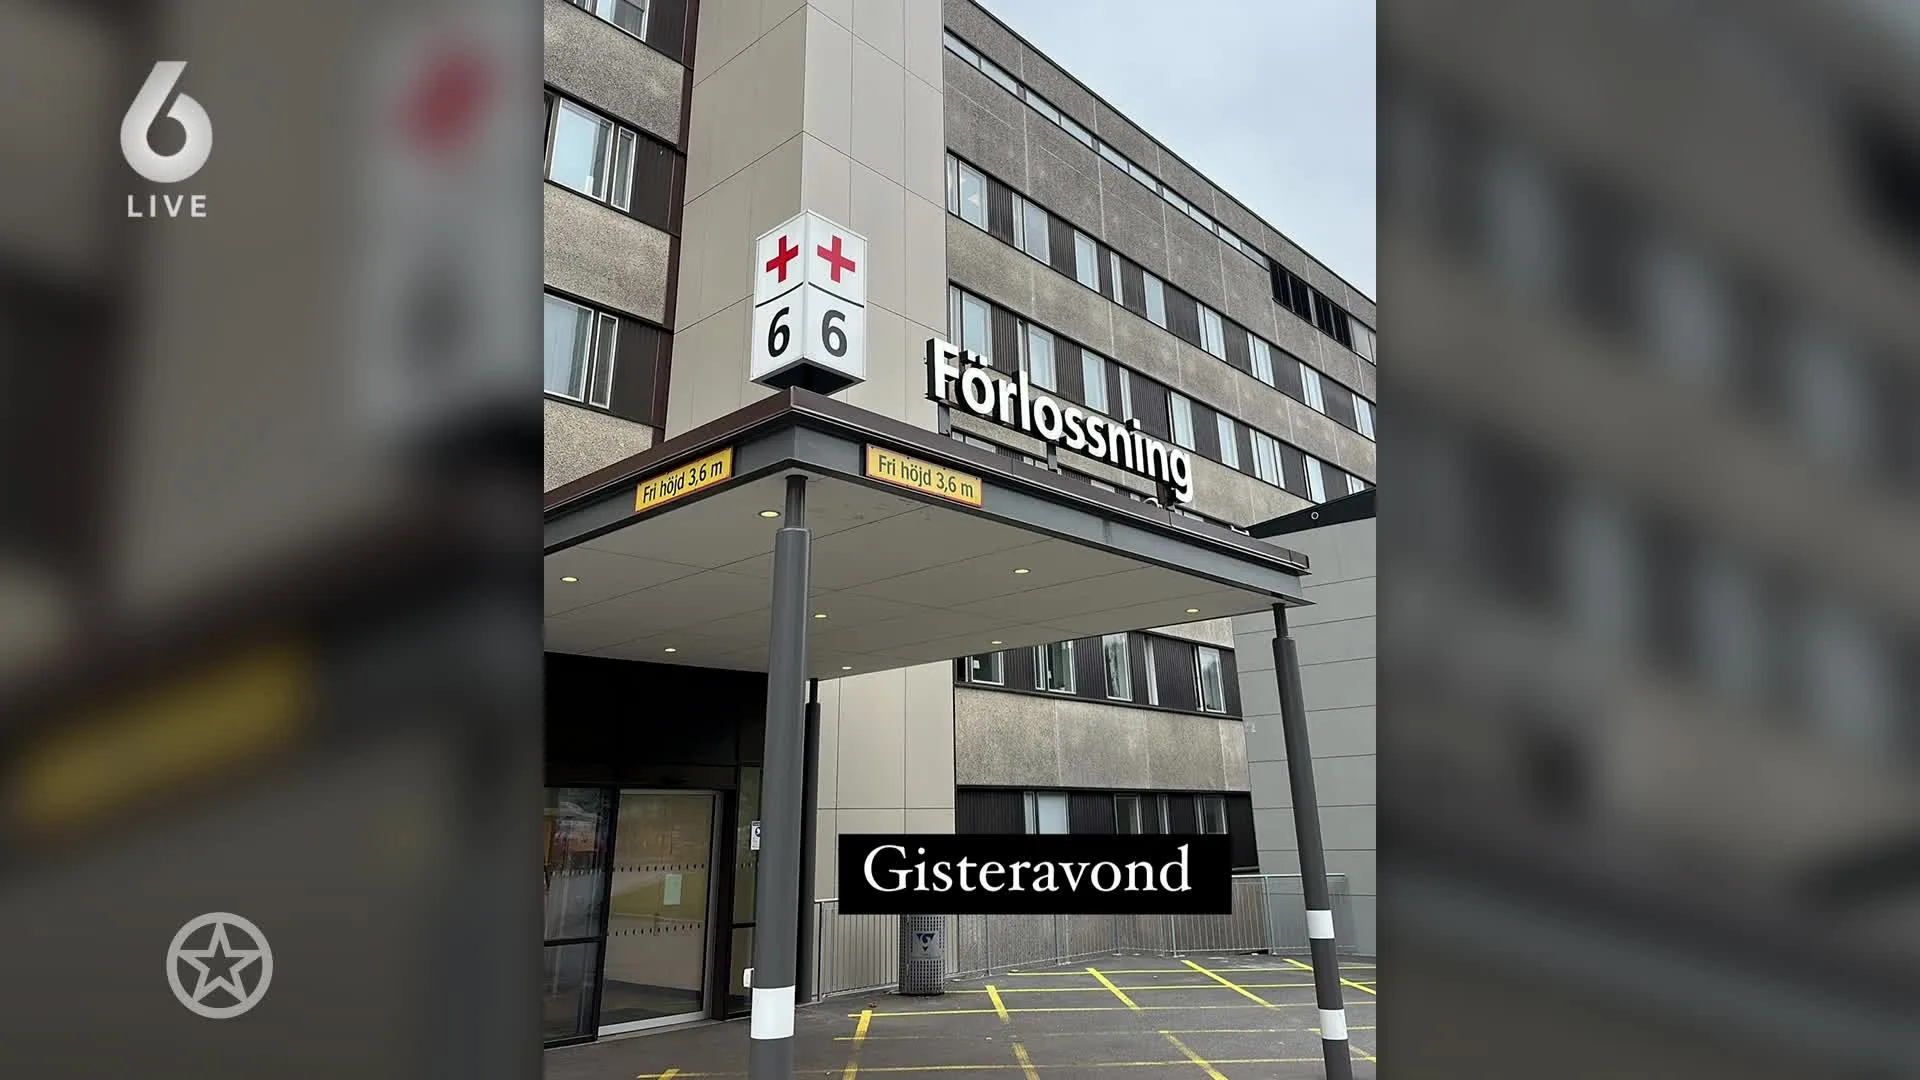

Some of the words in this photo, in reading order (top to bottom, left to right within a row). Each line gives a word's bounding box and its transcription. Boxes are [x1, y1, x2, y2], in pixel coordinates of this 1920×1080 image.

[768, 306, 790, 357] 6
[821, 309, 847, 357] 6
[927, 337, 1193, 503] Förlossning
[643, 483, 657, 503] Fri
[660, 471, 685, 497] höjd
[688, 465, 706, 487] 3,6
[711, 460, 723, 479] m
[878, 455, 896, 476] Fri
[901, 461, 931, 487] höjd
[936, 472, 957, 493] 3,6
[961, 485, 973, 498] m
